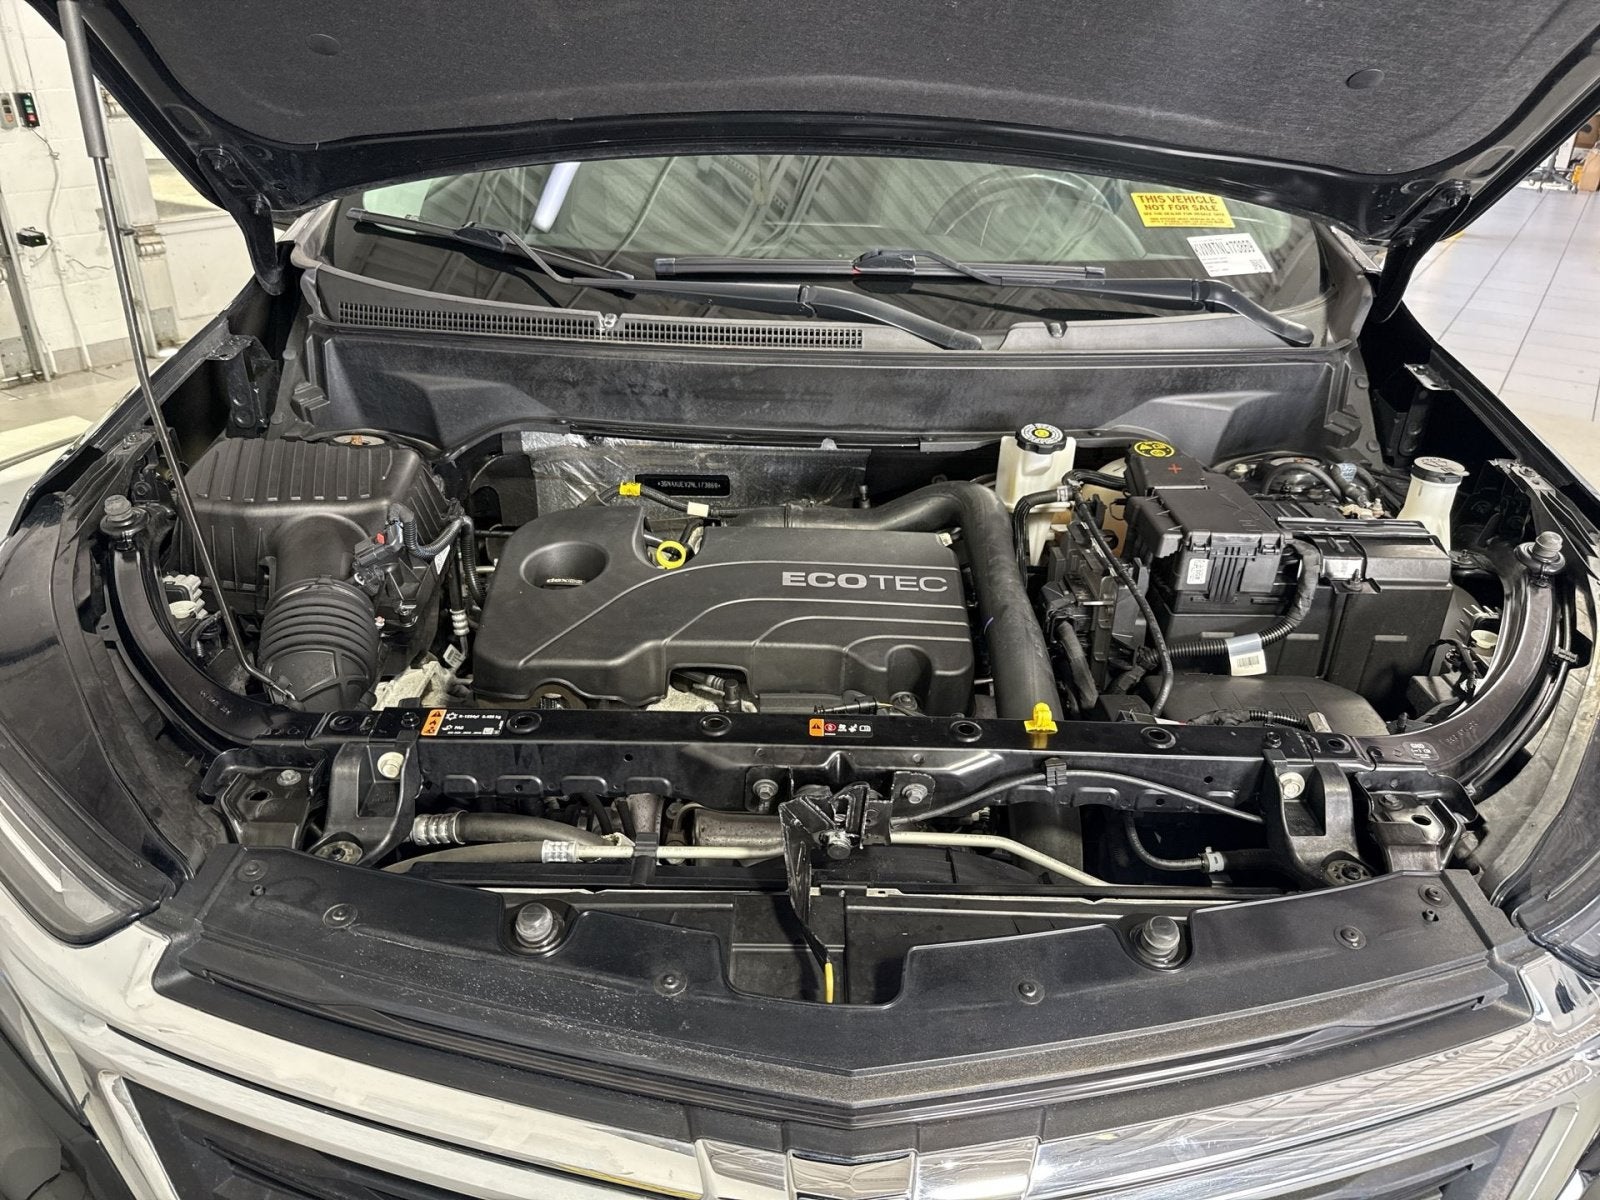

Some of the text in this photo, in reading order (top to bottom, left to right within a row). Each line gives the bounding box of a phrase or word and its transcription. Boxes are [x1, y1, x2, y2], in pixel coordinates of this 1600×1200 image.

[1137, 195, 1217, 204] THIS VEHICLE
[1192, 204, 1219, 212] SALE
[782, 571, 948, 592] ECOTEC
